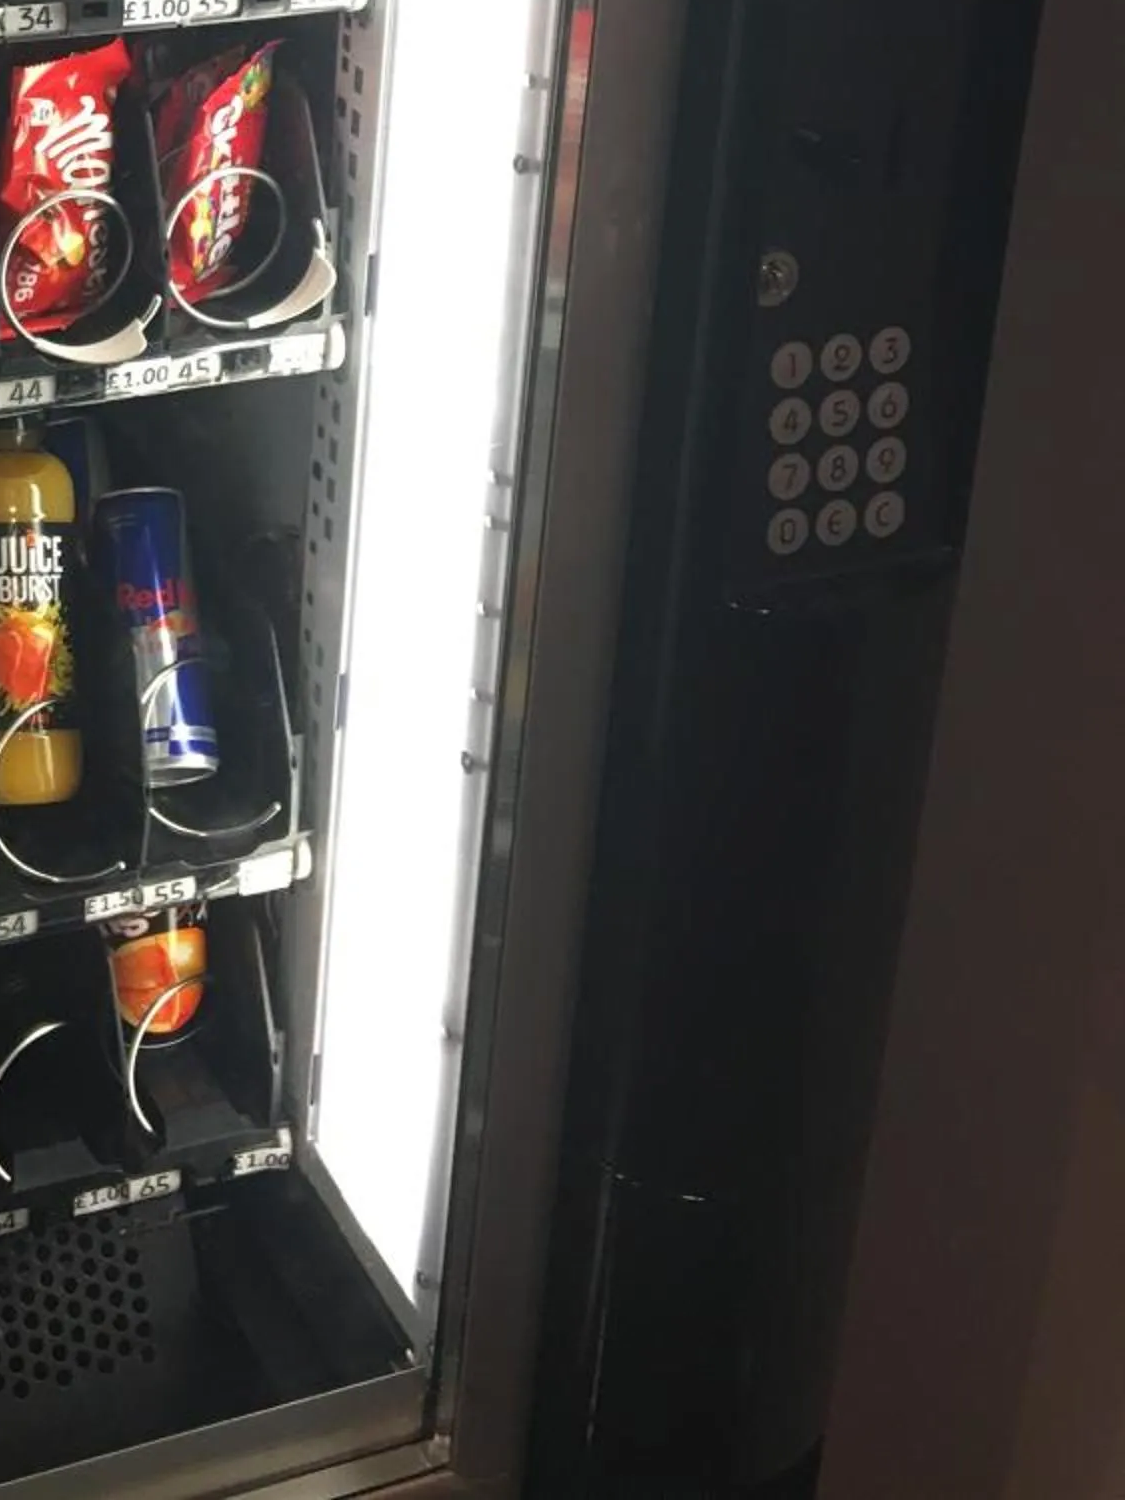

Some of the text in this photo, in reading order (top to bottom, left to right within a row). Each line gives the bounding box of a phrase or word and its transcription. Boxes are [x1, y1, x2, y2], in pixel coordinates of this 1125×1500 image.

[18, 7, 53, 31] 34
[195, 94, 244, 283] Skttles
[833, 344, 852, 371] 2
[883, 337, 899, 365] 3
[107, 361, 212, 389] £1.00 45
[787, 353, 797, 379] 1
[7, 381, 43, 405] 44
[881, 392, 898, 420] 6
[783, 408, 799, 435] 4
[831, 399, 850, 428] 5
[829, 455, 847, 483] 8
[878, 447, 896, 474] 9
[782, 463, 799, 492] 7
[875, 501, 891, 528] C
[780, 517, 797, 546] 0
[117, 578, 175, 611] Red
[154, 881, 185, 901] 55
[233, 1152, 292, 1172] £1.00
[75, 1174, 171, 1210] £1.00 65
